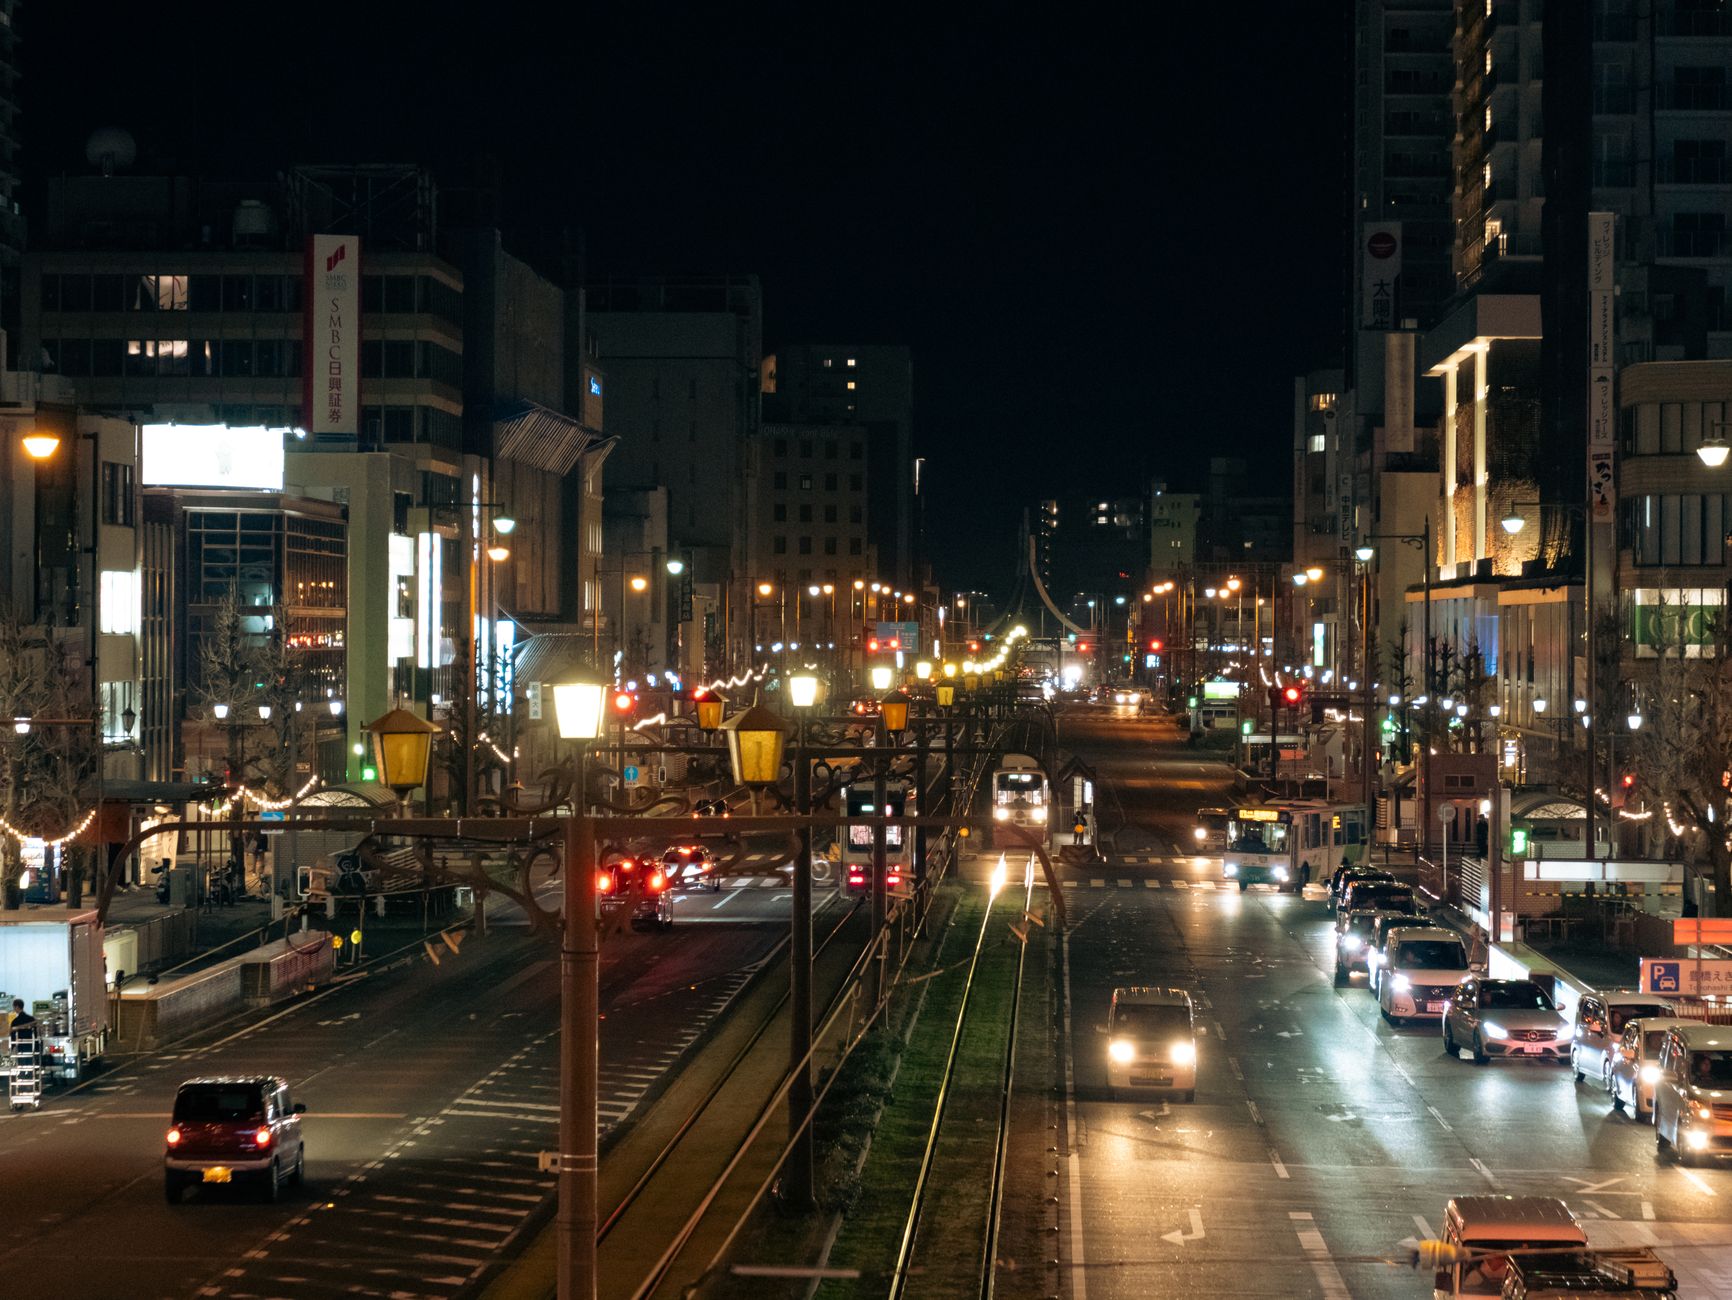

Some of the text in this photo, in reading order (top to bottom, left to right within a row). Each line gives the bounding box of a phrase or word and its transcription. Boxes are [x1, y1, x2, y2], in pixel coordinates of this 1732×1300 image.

[329, 298, 342, 423] SMBC日興証券
[1653, 965, 1665, 981] P
